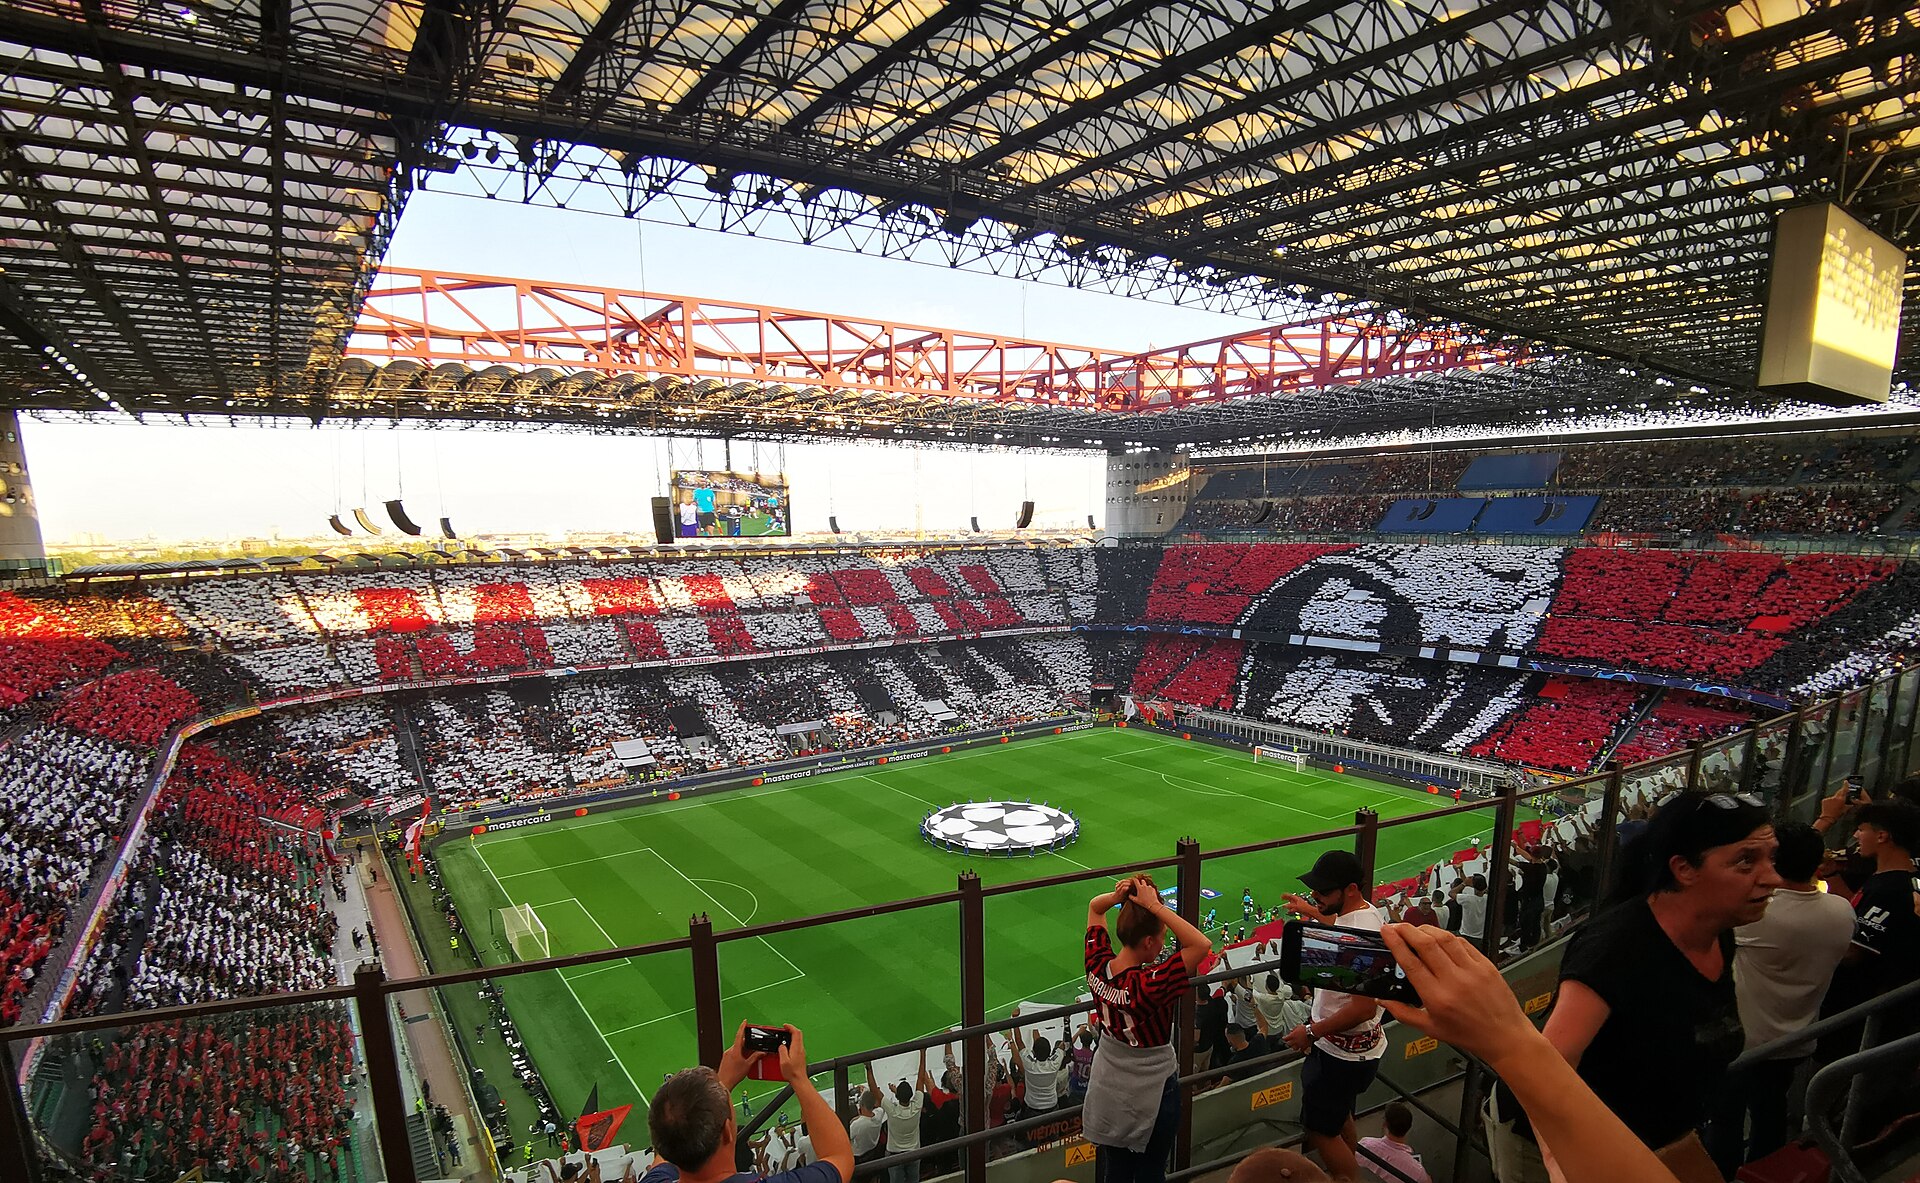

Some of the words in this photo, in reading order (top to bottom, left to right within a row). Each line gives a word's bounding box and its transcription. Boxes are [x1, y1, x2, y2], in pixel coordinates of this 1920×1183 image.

[1062, 722, 1094, 733] mastercard
[888, 750, 928, 763] mastercard
[1262, 750, 1304, 764] mastercad
[764, 769, 811, 784] mastercard
[488, 814, 551, 832] mastercard
[1026, 1120, 1069, 1142] VIETATO
